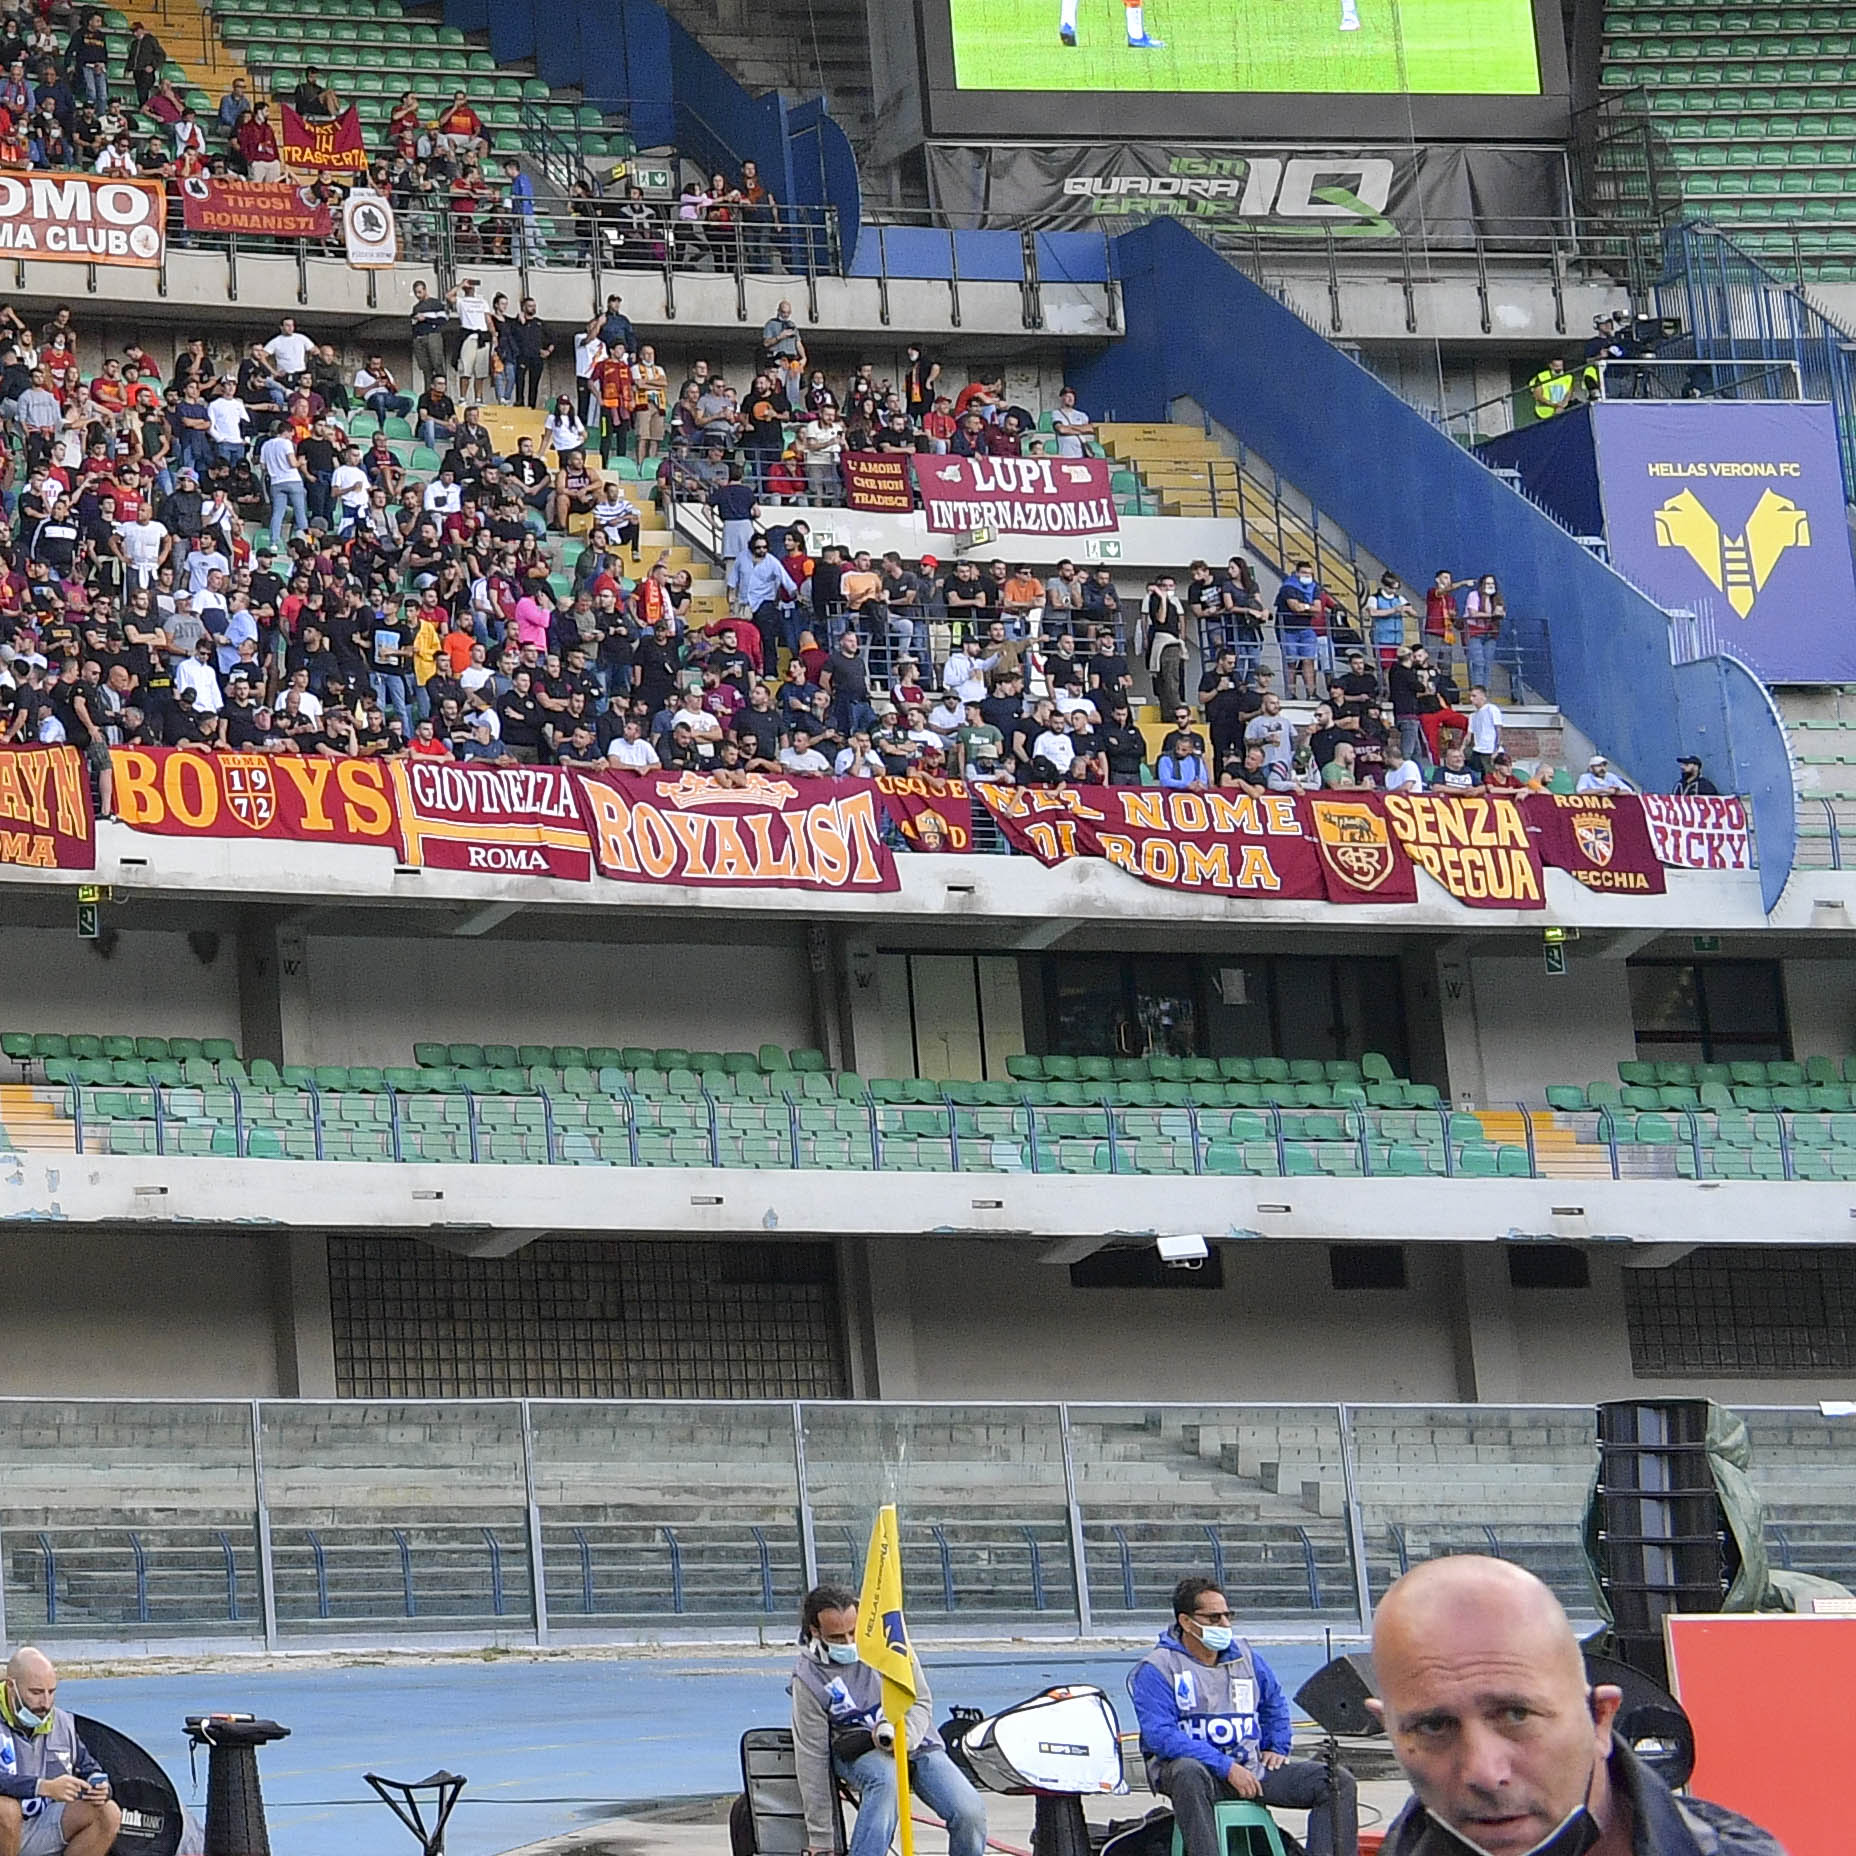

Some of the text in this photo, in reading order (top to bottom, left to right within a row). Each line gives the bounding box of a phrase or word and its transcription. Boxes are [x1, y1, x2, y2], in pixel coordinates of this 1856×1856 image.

[284, 146, 368, 170] TRASFERTA
[1063, 177, 1240, 197] QUADRA
[224, 194, 291, 209] TIFOSI
[202, 212, 314, 230] ROMANISTI
[46, 225, 128, 254] CLUB
[968, 456, 1057, 493] LUPI
[1648, 463, 1801, 477] HELLAS VERONA FC
[853, 476, 904, 491] CHE NON
[853, 492, 908, 507] TRADISCE
[930, 499, 1113, 532] INTERNAZIONALI
[221, 756, 267, 767] ROMA
[413, 763, 579, 819] GIOVINEZZA
[875, 776, 968, 799] USQUE
[1118, 791, 1303, 836] NOME
[1555, 795, 1616, 811] ROMA
[578, 775, 884, 886] ROYALIST
[1384, 795, 1530, 848] SENZA
[468, 846, 550, 870] ROMA
[1654, 825, 1744, 868] RICKY
[1096, 832, 1282, 890] ROMA
[1573, 870, 1650, 890] ECCHIA
[865, 1594, 879, 1638] HELLAS
